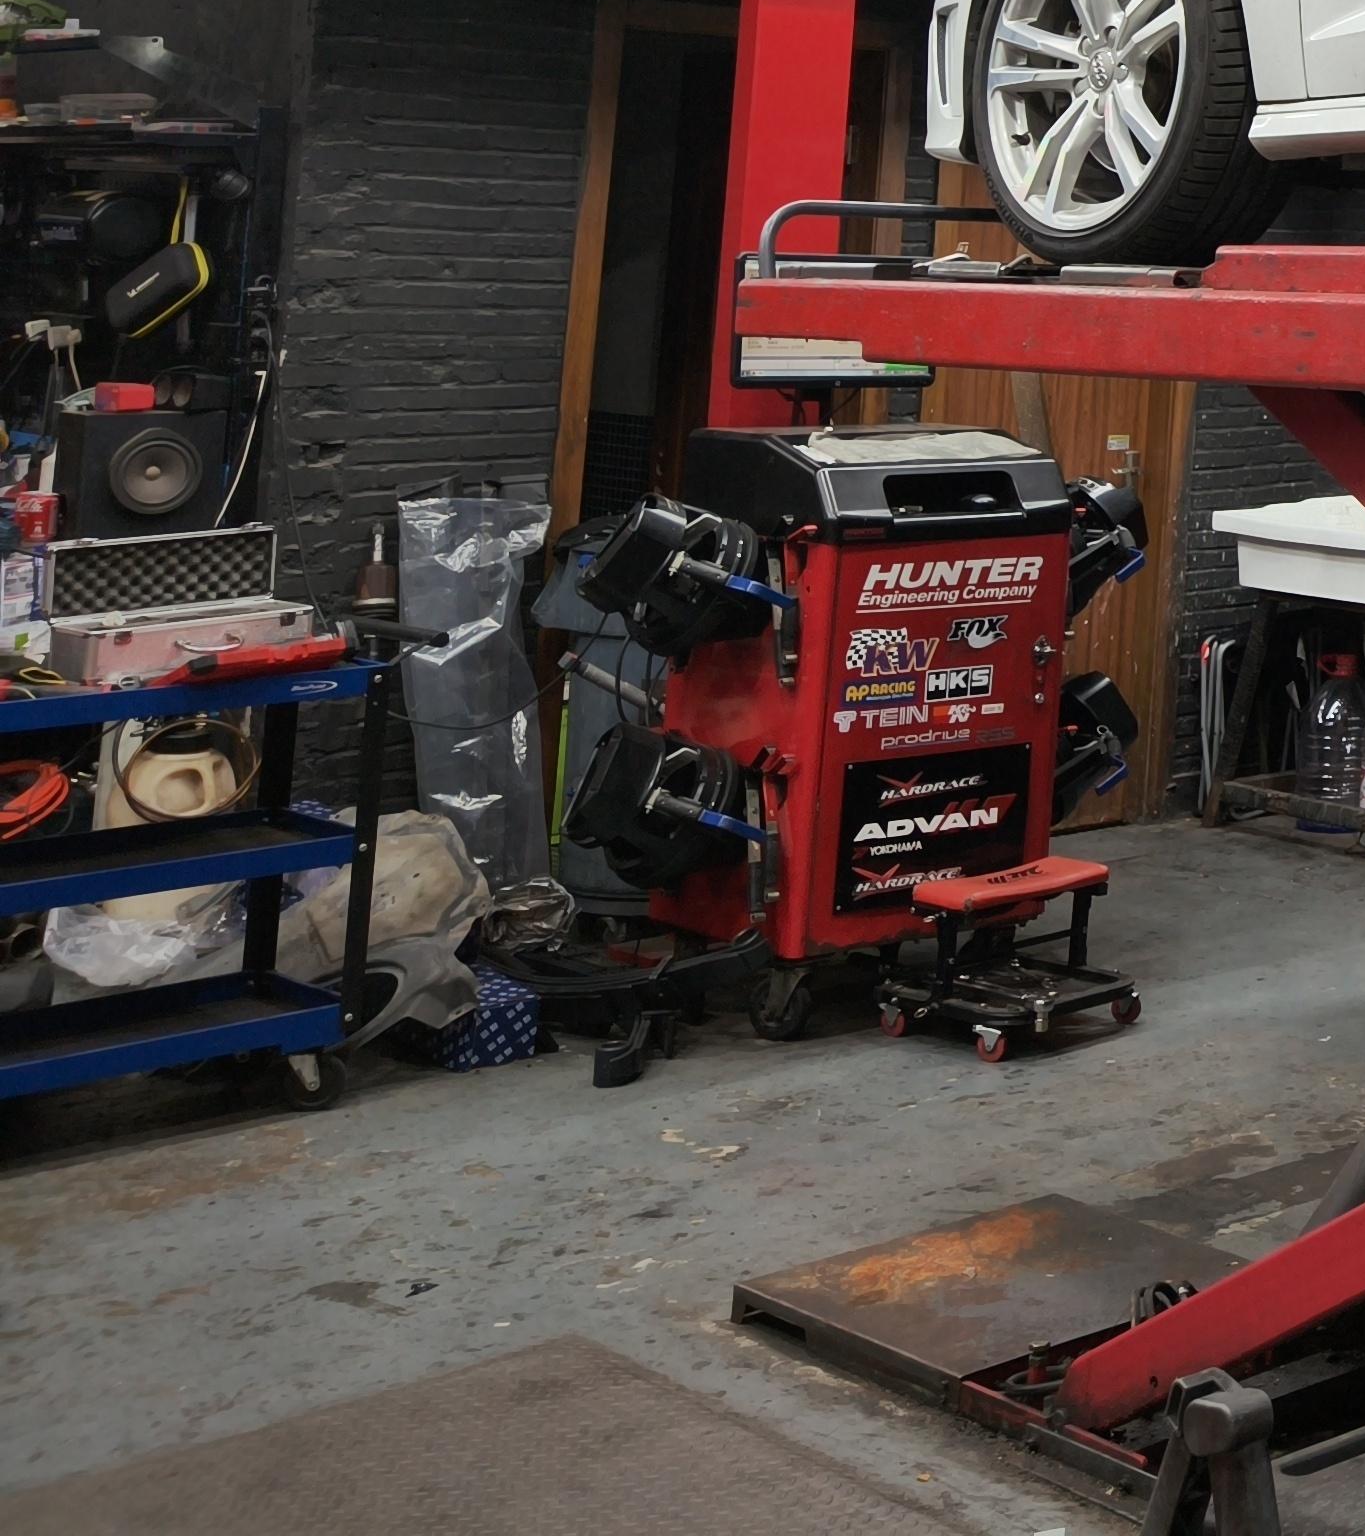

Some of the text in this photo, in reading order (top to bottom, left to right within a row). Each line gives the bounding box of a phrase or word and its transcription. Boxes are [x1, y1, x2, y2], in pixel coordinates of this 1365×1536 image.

[863, 556, 1044, 591] HUNTER
[857, 584, 1038, 608] Engineering Company
[950, 616, 1005, 641] FOX
[860, 638, 940, 678] KW
[845, 684, 869, 703] AP
[870, 680, 916, 696] RACING
[929, 668, 990, 693] HKS
[861, 704, 929, 729] TEIN
[881, 728, 971, 750] prodrive
[880, 775, 982, 800] HARDRACE
[853, 807, 999, 843] ADVAN
[869, 840, 923, 857] YOKOHAMA
[855, 865, 962, 894] HARDRACE
